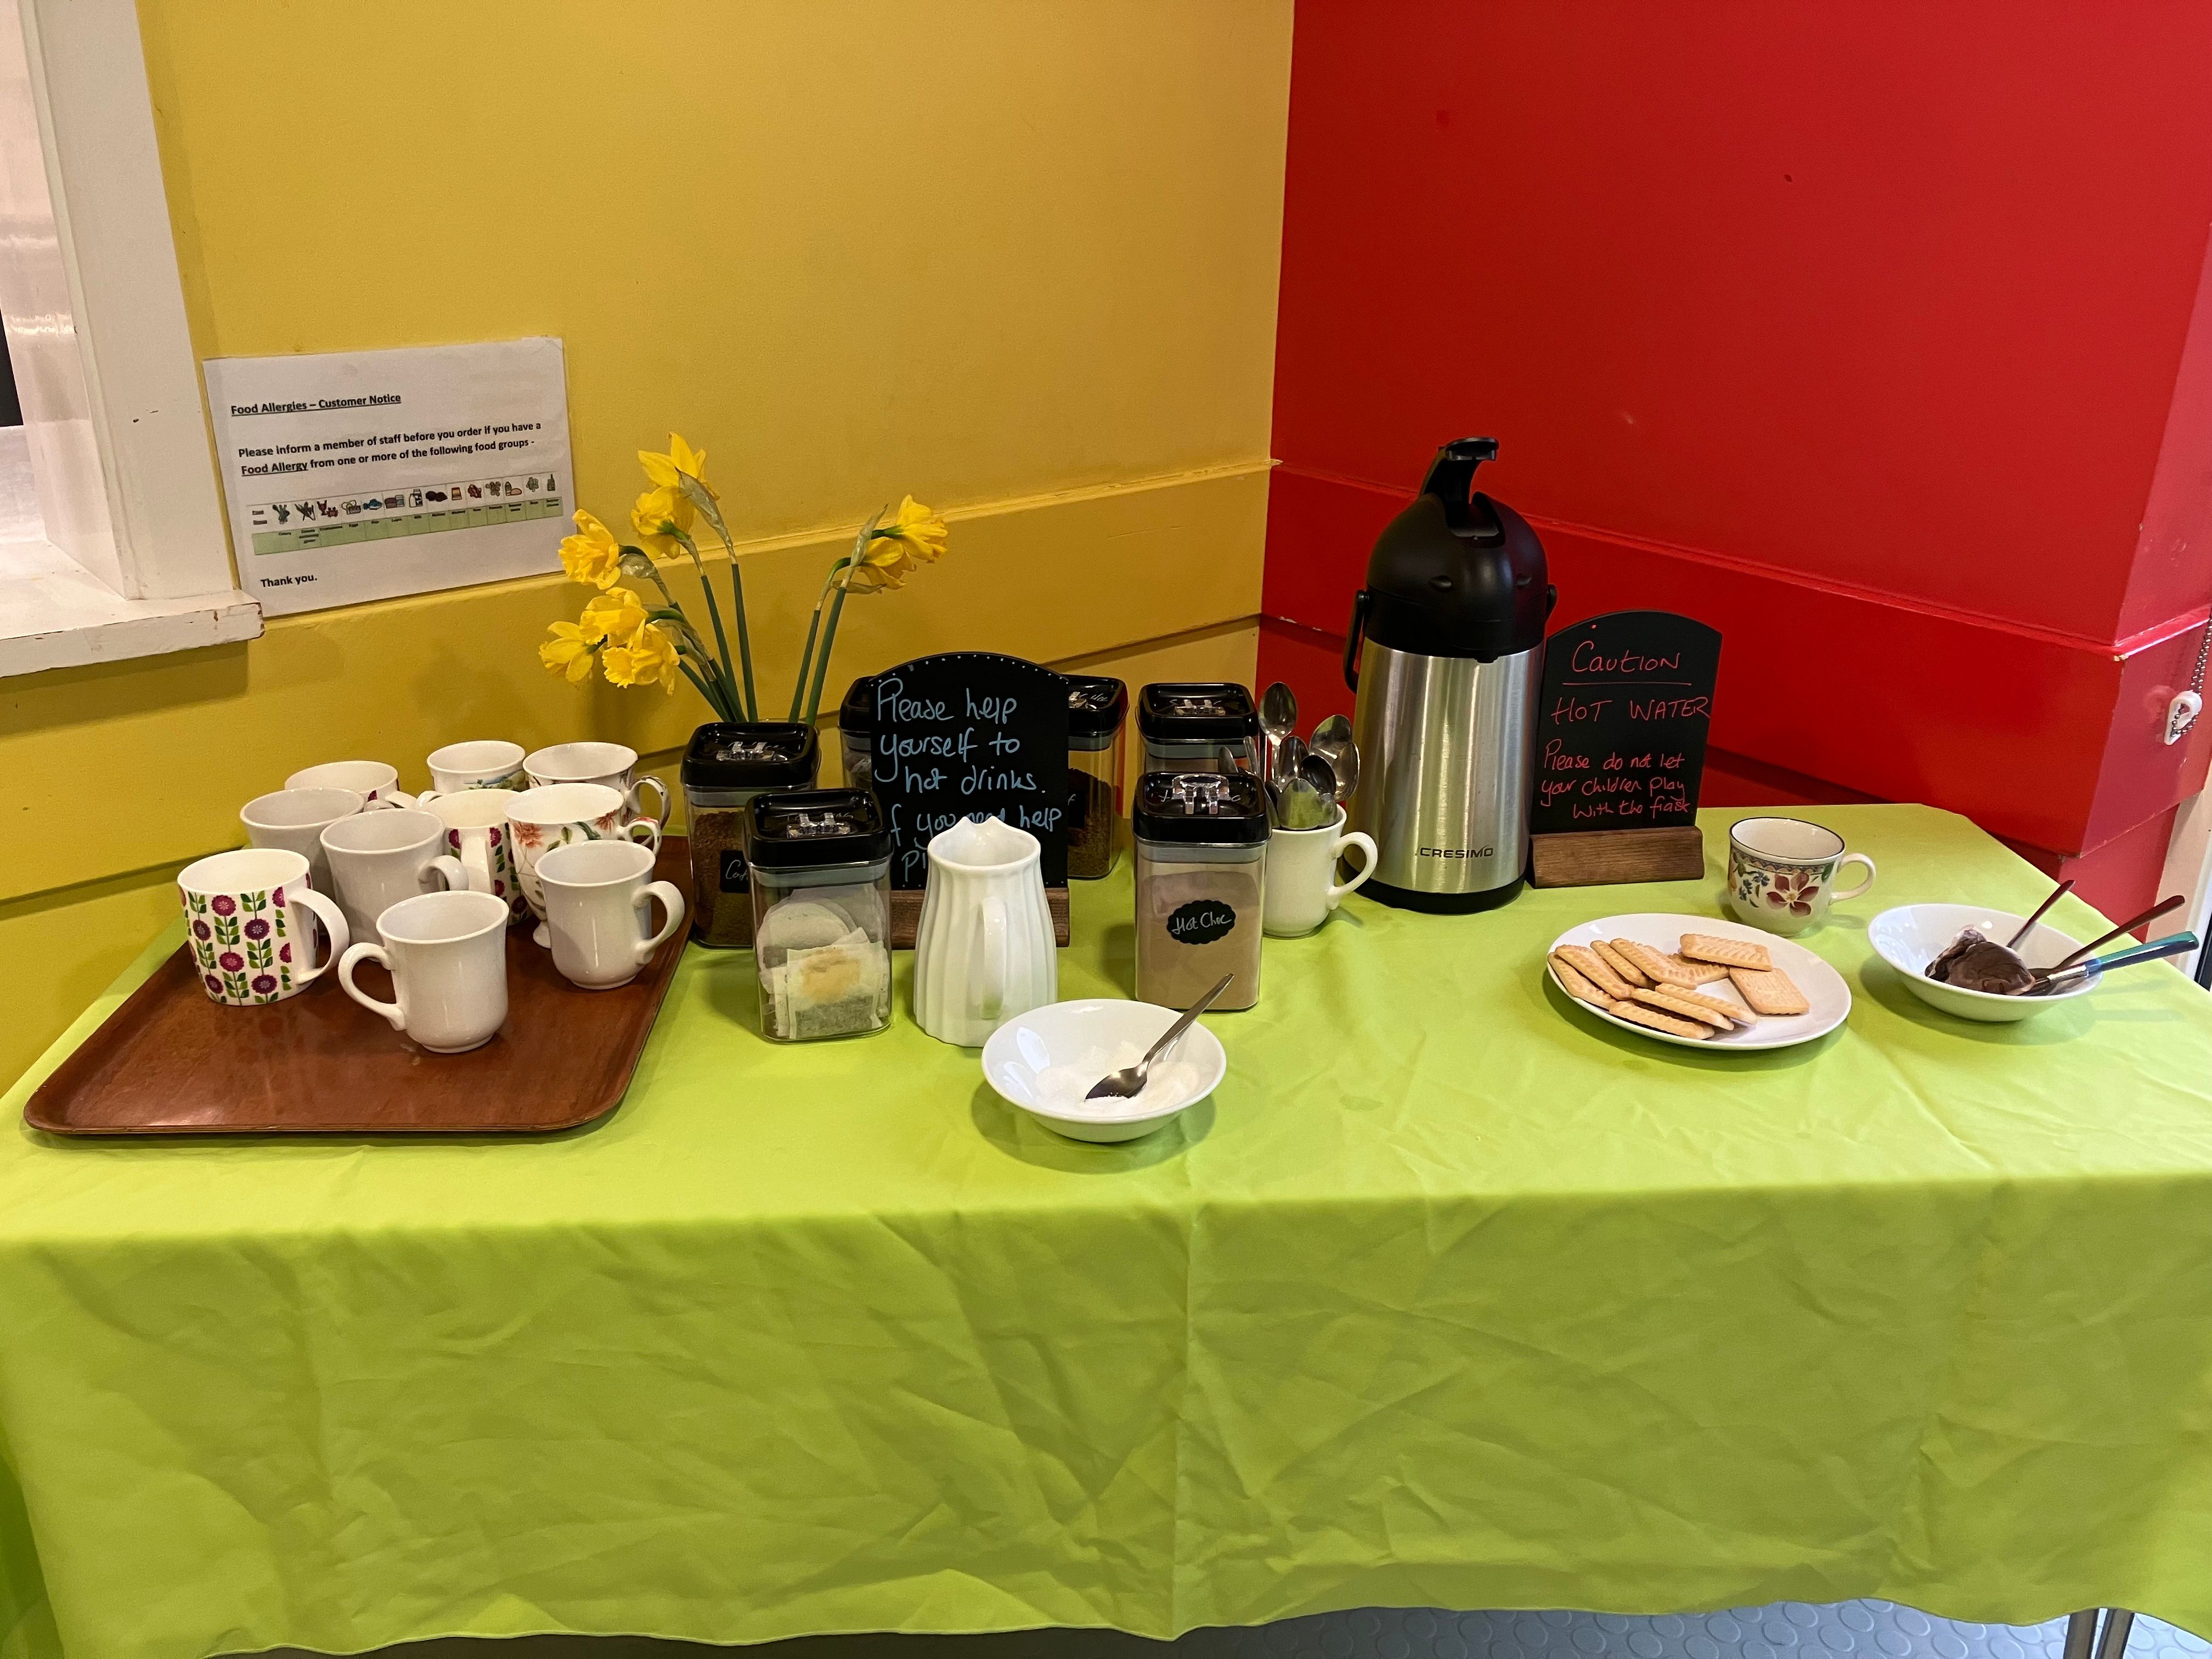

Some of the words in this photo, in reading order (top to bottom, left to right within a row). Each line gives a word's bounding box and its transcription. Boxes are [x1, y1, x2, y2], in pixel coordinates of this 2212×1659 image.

[231, 404, 258, 415] Food
[262, 401, 307, 413] Allergies
[319, 397, 366, 409] Customer
[369, 393, 401, 404] Notice
[239, 447, 273, 458] Please
[276, 444, 311, 454] inform
[323, 439, 365, 450] member
[367, 436, 377, 446] of
[380, 434, 401, 444] staff
[404, 432, 435, 443] before
[437, 431, 454, 441] you
[457, 427, 482, 437] order
[484, 425, 490, 435] if
[493, 426, 510, 435] you
[512, 423, 533, 432] have
[241, 464, 268, 475] Food
[272, 461, 308, 472] Allergy
[310, 459, 335, 468] from
[337, 456, 356, 466] one
[371, 452, 397, 462] more
[399, 449, 409, 459] of
[411, 448, 427, 458] the
[430, 444, 473, 456] following
[475, 441, 496, 452] food
[499, 440, 529, 450] groups
[260, 575, 293, 588] Thank
[295, 574, 318, 585] you.
[878, 678, 955, 722] Please
[966, 687, 1017, 724] help
[1630, 697, 1711, 721] WATER
[874, 727, 979, 782] yourself
[989, 731, 1020, 755] to
[1544, 739, 1590, 771] Please
[1603, 751, 1623, 770] do
[1630, 753, 1651, 768] not
[1660, 753, 1686, 769] let
[905, 766, 947, 793] hot
[1541, 779, 1577, 806] your
[1620, 800, 1643, 815] the
[1650, 795, 1691, 819] flask
[914, 814, 956, 850] you
[1019, 805, 1062, 832] help
[1420, 845, 1493, 858] CRESIMO
[1172, 917, 1198, 934] Hot
[1200, 911, 1232, 928] Choc
